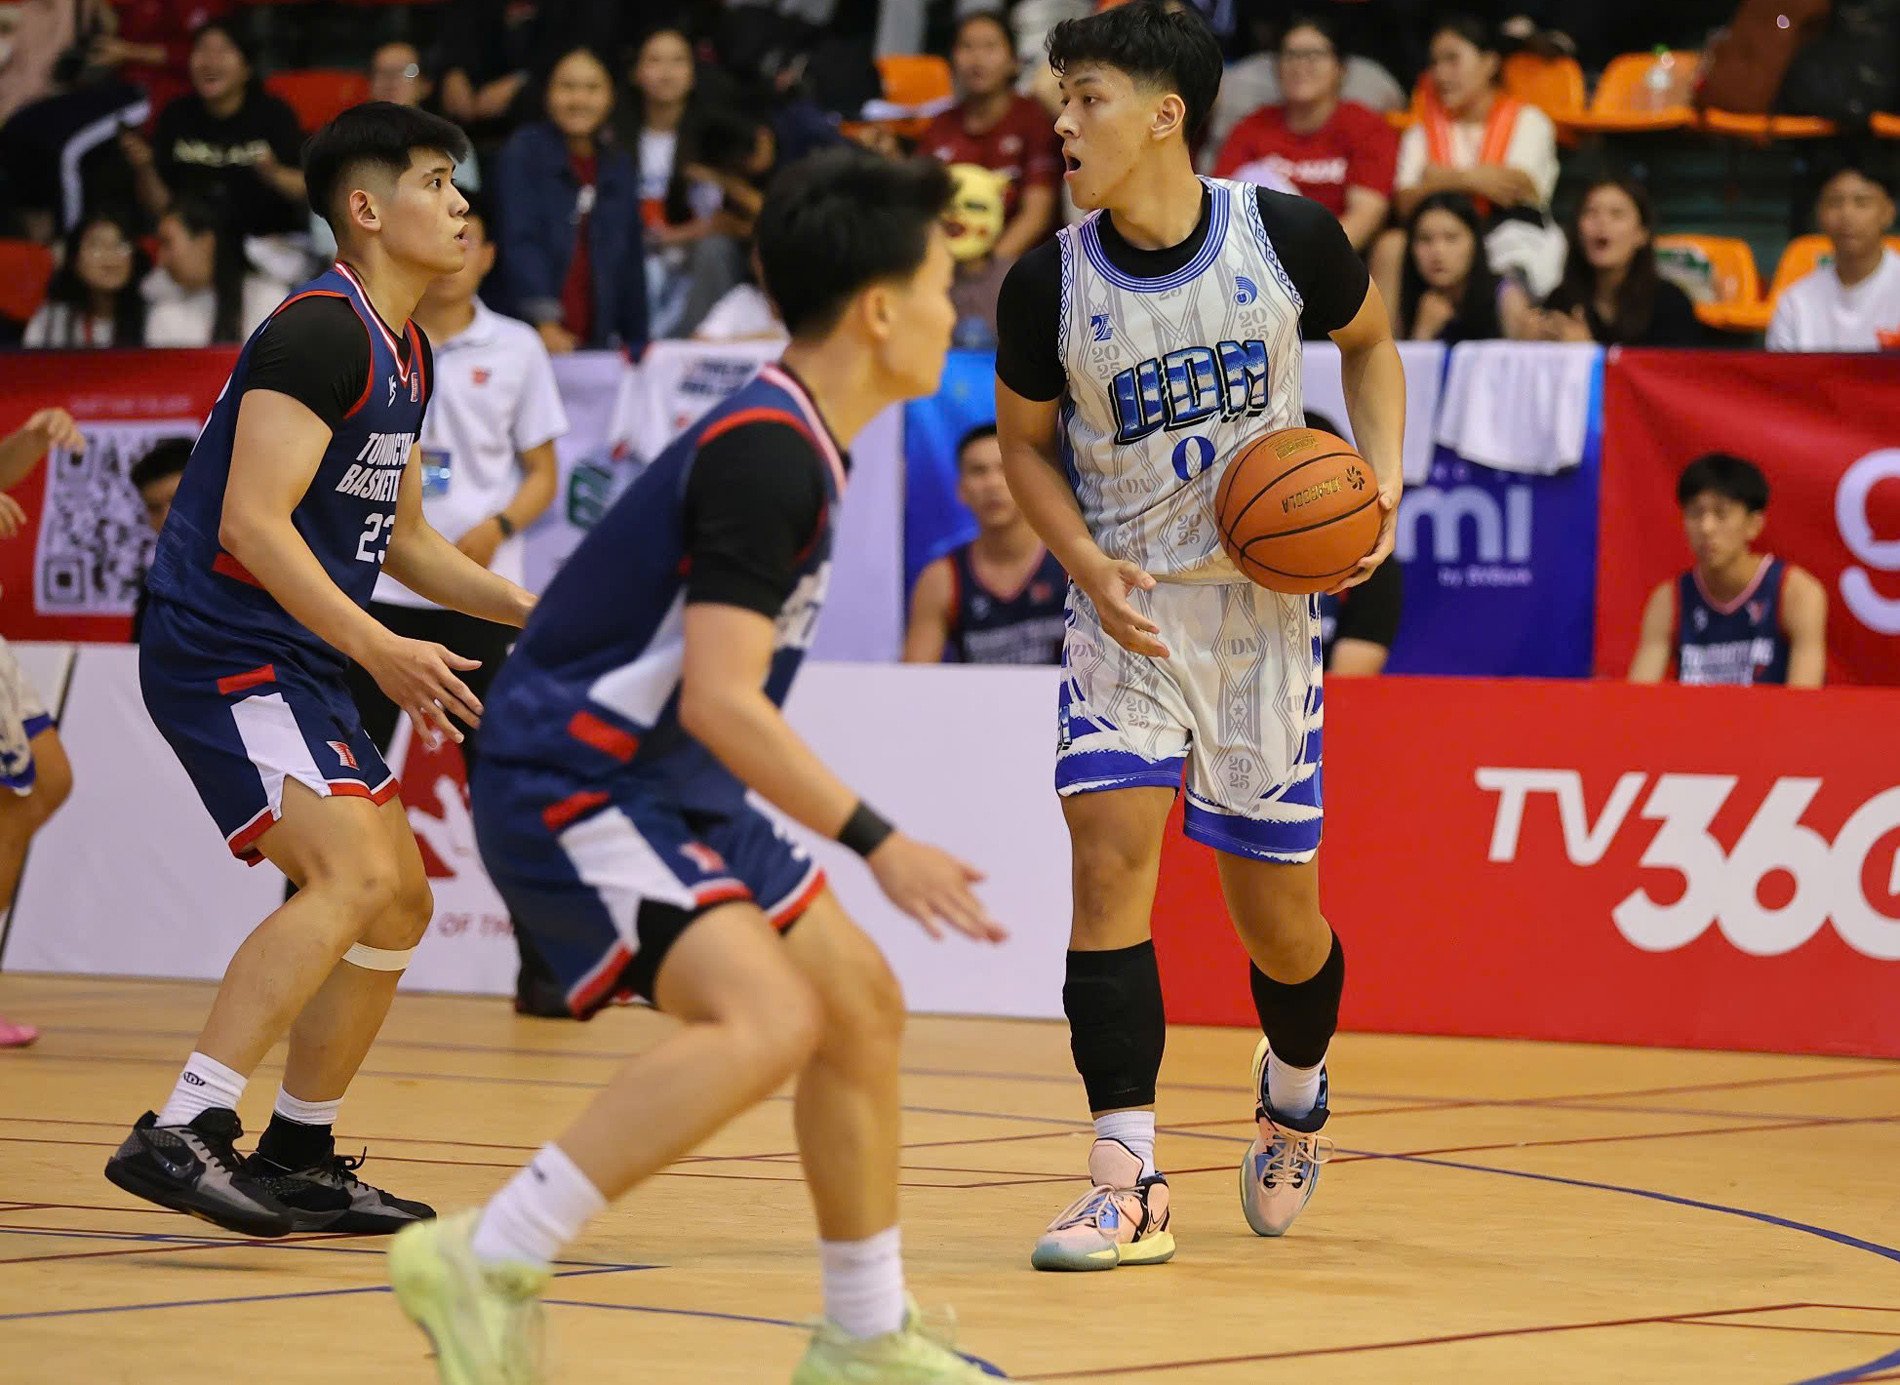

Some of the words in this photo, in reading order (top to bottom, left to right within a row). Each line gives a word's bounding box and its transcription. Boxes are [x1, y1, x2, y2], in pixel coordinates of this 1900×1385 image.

[1238, 307, 1268, 328] 20
[1091, 344, 1121, 363] 20
[1108, 340, 1269, 445] UDN
[1177, 514, 1202, 530] 20
[1177, 529, 1201, 547] 25
[1220, 637, 1258, 657] UDN
[1125, 696, 1151, 715] 20
[1228, 755, 1253, 774] 20
[1229, 772, 1251, 791] 25
